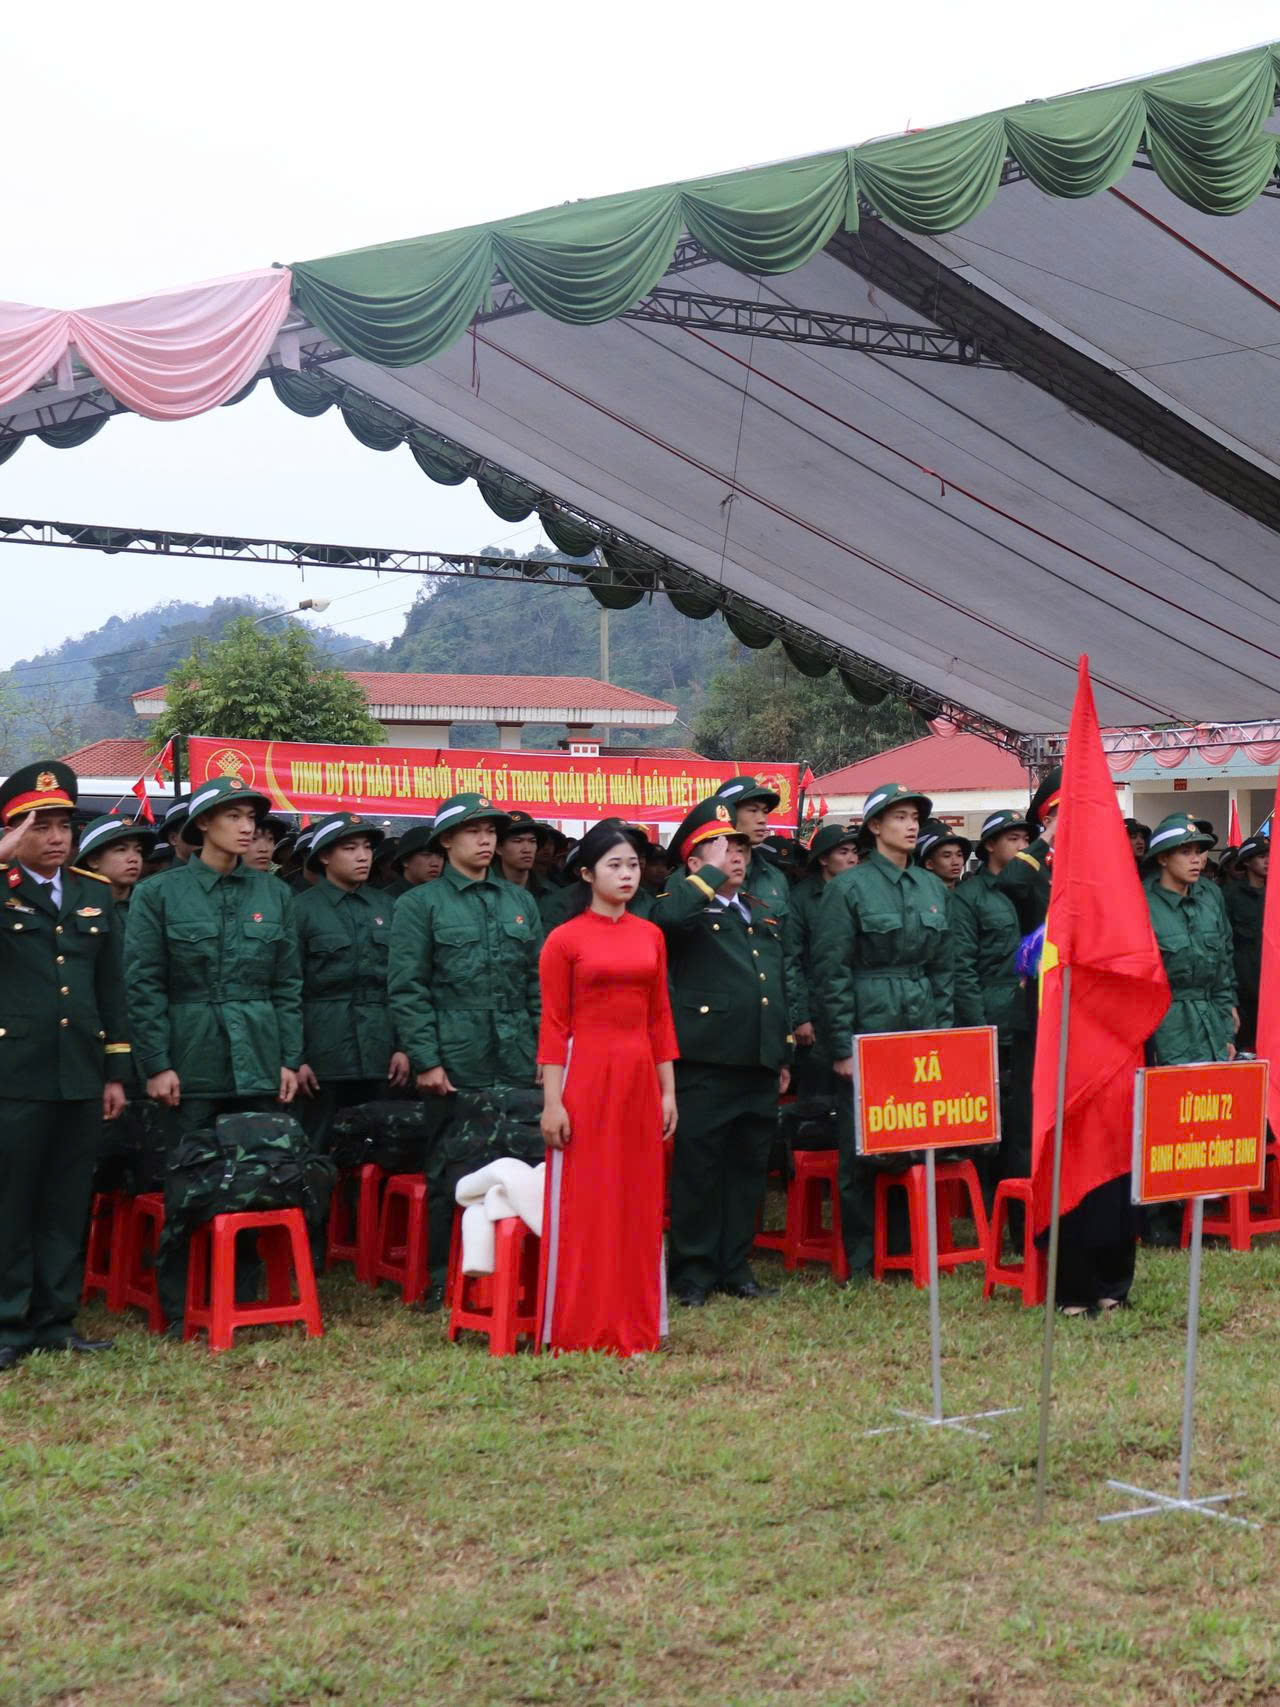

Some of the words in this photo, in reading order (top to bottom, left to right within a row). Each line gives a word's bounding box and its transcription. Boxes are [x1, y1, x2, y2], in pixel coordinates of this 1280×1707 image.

[290, 760, 323, 795] VINH
[325, 759, 345, 802] DỰ
[346, 760, 364, 803] TỰ
[366, 757, 392, 797] HÀO
[394, 758, 411, 798] LÀ
[413, 758, 452, 799] NGƯỜI
[455, 757, 492, 800] CHIẾN
[495, 763, 508, 801] SĨ
[510, 769, 550, 802] TRONG
[552, 766, 585, 806] QUÂN
[588, 767, 607, 811] ĐỘI
[609, 768, 642, 805] NHÂN
[644, 769, 668, 806] DÂN
[670, 770, 694, 813] VIỆT
[913, 1049, 943, 1083] XÃ
[868, 1095, 928, 1133] ĐỒNG
[931, 1091, 989, 1127] PHÚC
[1179, 1091, 1194, 1124] LỮ
[1193, 1089, 1219, 1123] ĐOÀN
[1221, 1093, 1233, 1120] 72
[1150, 1143, 1174, 1173] BINH
[1175, 1133, 1207, 1171] CHỦNG
[1208, 1133, 1234, 1168] CÔNG
[1234, 1137, 1257, 1165] BINH
